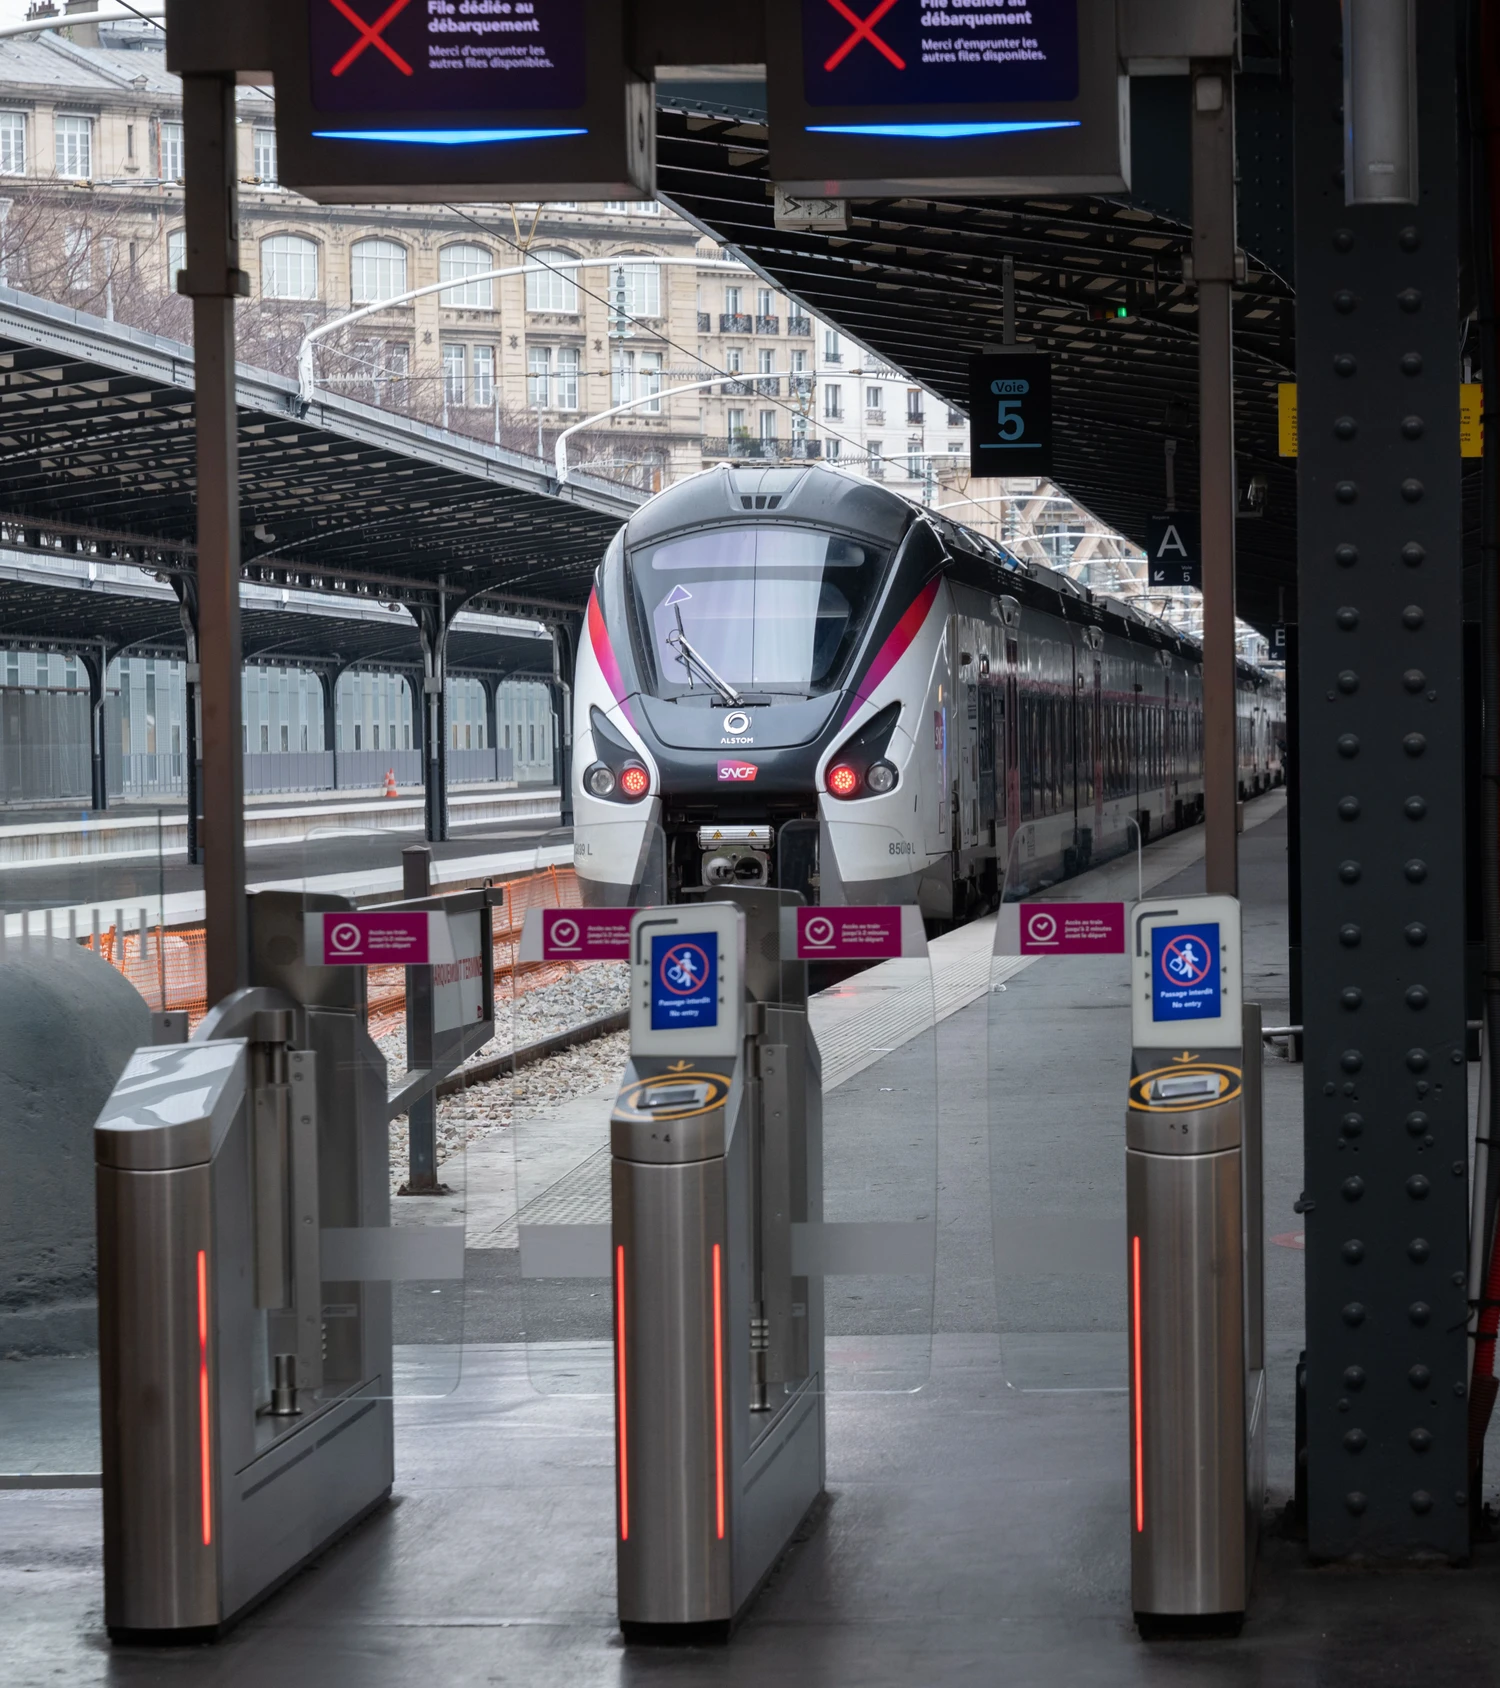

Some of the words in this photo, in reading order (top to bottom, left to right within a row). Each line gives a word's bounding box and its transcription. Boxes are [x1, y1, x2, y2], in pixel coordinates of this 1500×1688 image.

[428, 0, 455, 14] File
[459, 0, 511, 14] dédiée
[515, 2, 534, 13] au
[428, 17, 539, 35] débarquement
[921, 11, 1032, 29] débarquement
[922, 39, 952, 50] Merci
[954, 38, 1020, 51] d'emprunter
[1022, 37, 1038, 48] les
[429, 45, 459, 56] Merci
[461, 45, 527, 58] d'emprunter
[529, 44, 545, 55] les
[922, 52, 956, 62] autres
[958, 50, 981, 61] files
[982, 49, 1046, 63] disponibles.
[429, 59, 463, 69] autres
[465, 57, 488, 68] files
[490, 57, 554, 70] disponibles.
[995, 381, 1024, 393] Voie
[998, 400, 1025, 441] 5
[1156, 525, 1188, 557] A
[1183, 571, 1190, 582] 5
[719, 767, 755, 779] SNCF
[1160, 990, 1188, 999] Passage
[1189, 987, 1213, 996] interdit
[1172, 1001, 1183, 1009] No
[1184, 1000, 1202, 1009] entry
[1182, 1124, 1188, 1134] 5
[663, 1134, 671, 1143] 4
